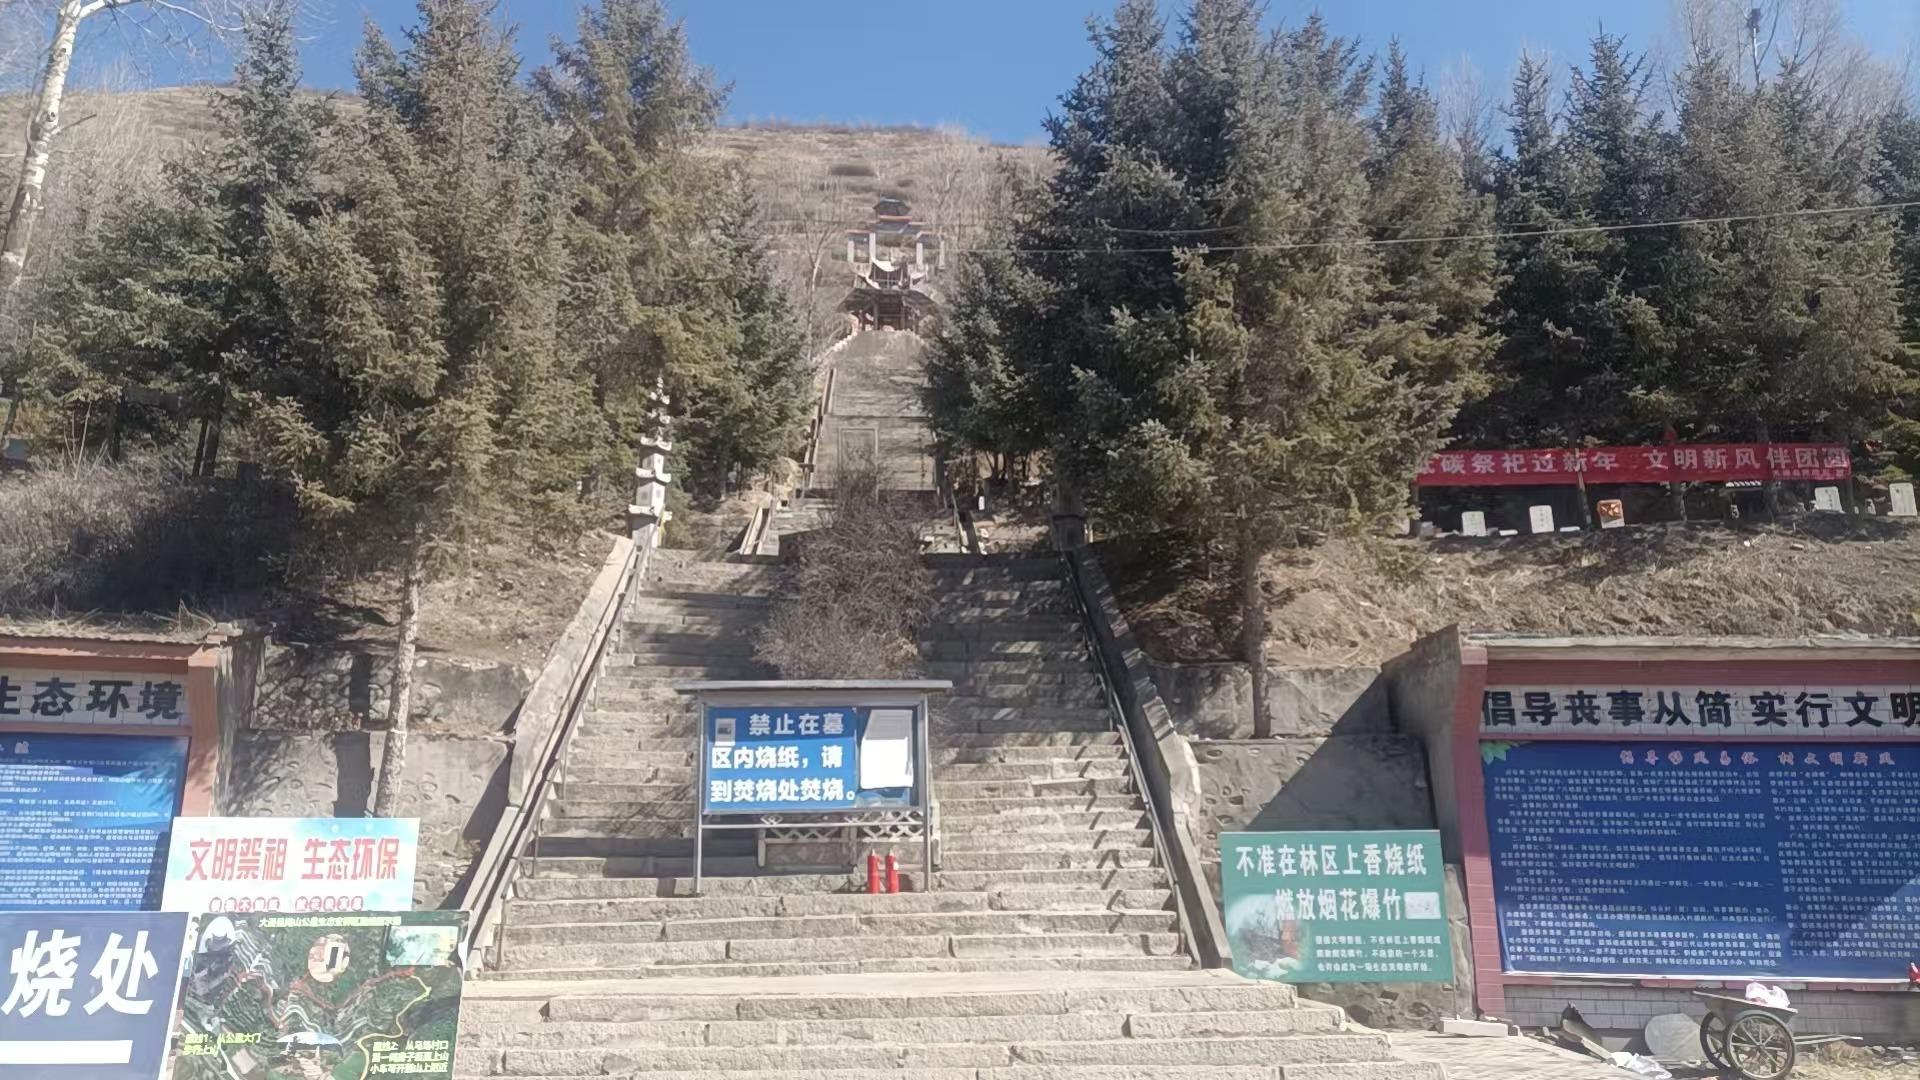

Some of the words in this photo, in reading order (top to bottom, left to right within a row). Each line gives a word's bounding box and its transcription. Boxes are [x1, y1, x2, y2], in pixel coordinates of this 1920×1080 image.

[1646, 447, 1850, 471] 文明新风伴团圆
[0, 675, 184, 720] 生态环境
[749, 713, 844, 736] 禁止在墓
[711, 745, 843, 769] 区内烧纸，请
[711, 779, 856, 803] 到焚烧处焚烧。
[185, 838, 289, 881] 文明祭祖
[301, 838, 400, 880] 生态环保
[1235, 843, 1427, 877] 不准在林区上香烧纸
[1275, 887, 1401, 921] 燃放烟花爆竹
[1, 929, 159, 1018] 烧处
